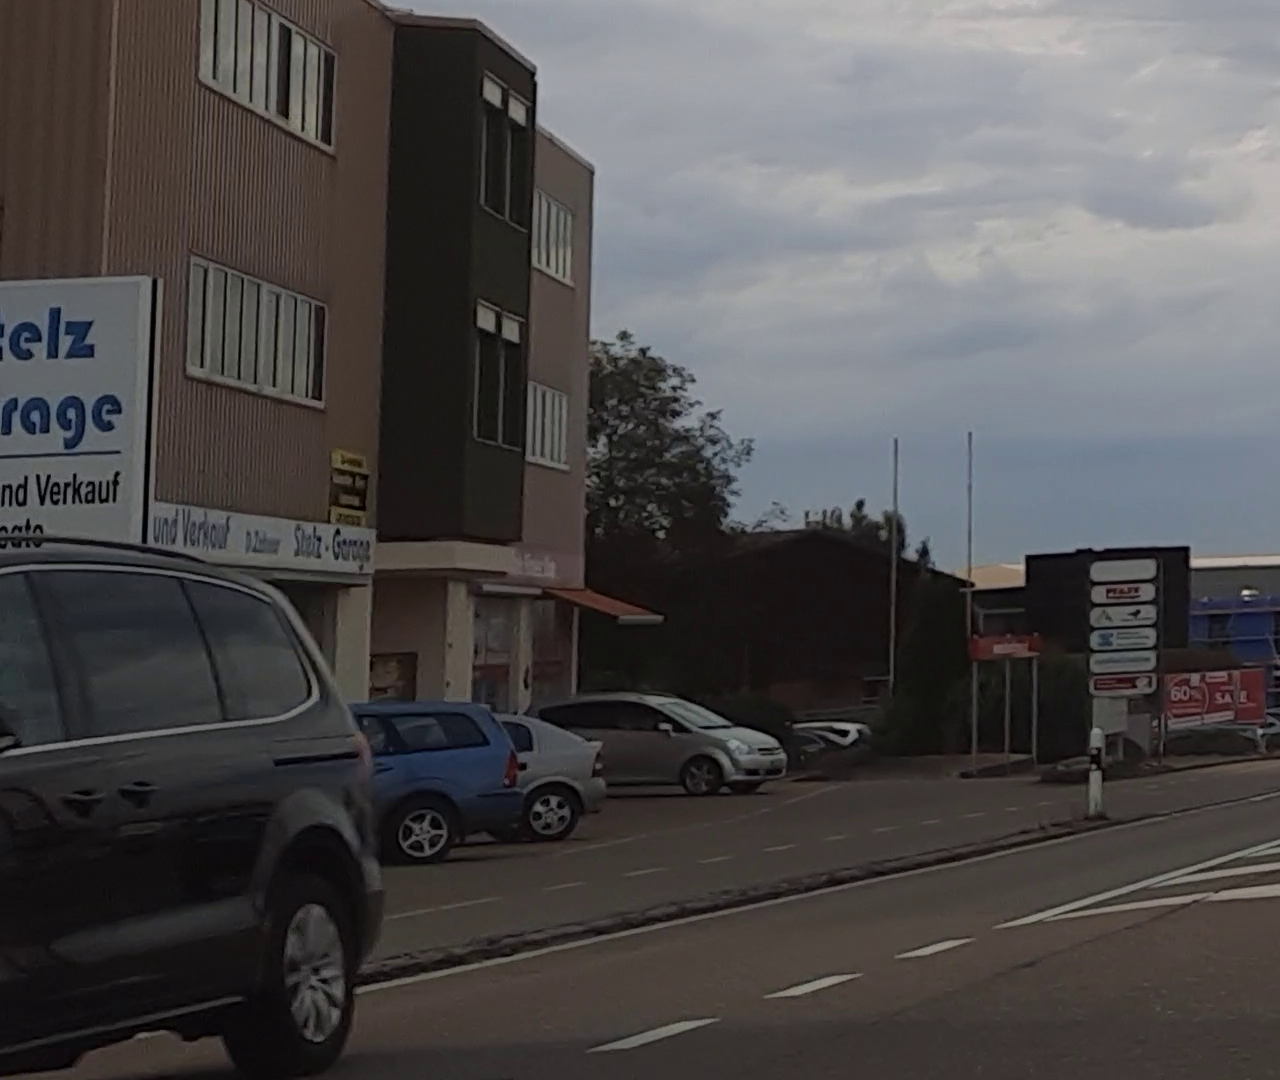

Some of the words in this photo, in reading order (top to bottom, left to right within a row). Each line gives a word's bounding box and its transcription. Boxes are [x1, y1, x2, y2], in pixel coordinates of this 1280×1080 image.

[0, 307, 95, 361] elz
[36, 470, 121, 507] Verkauf
[153, 508, 178, 545] und
[182, 508, 231, 551] Verkauf
[1214, 690, 1249, 704] SAE
